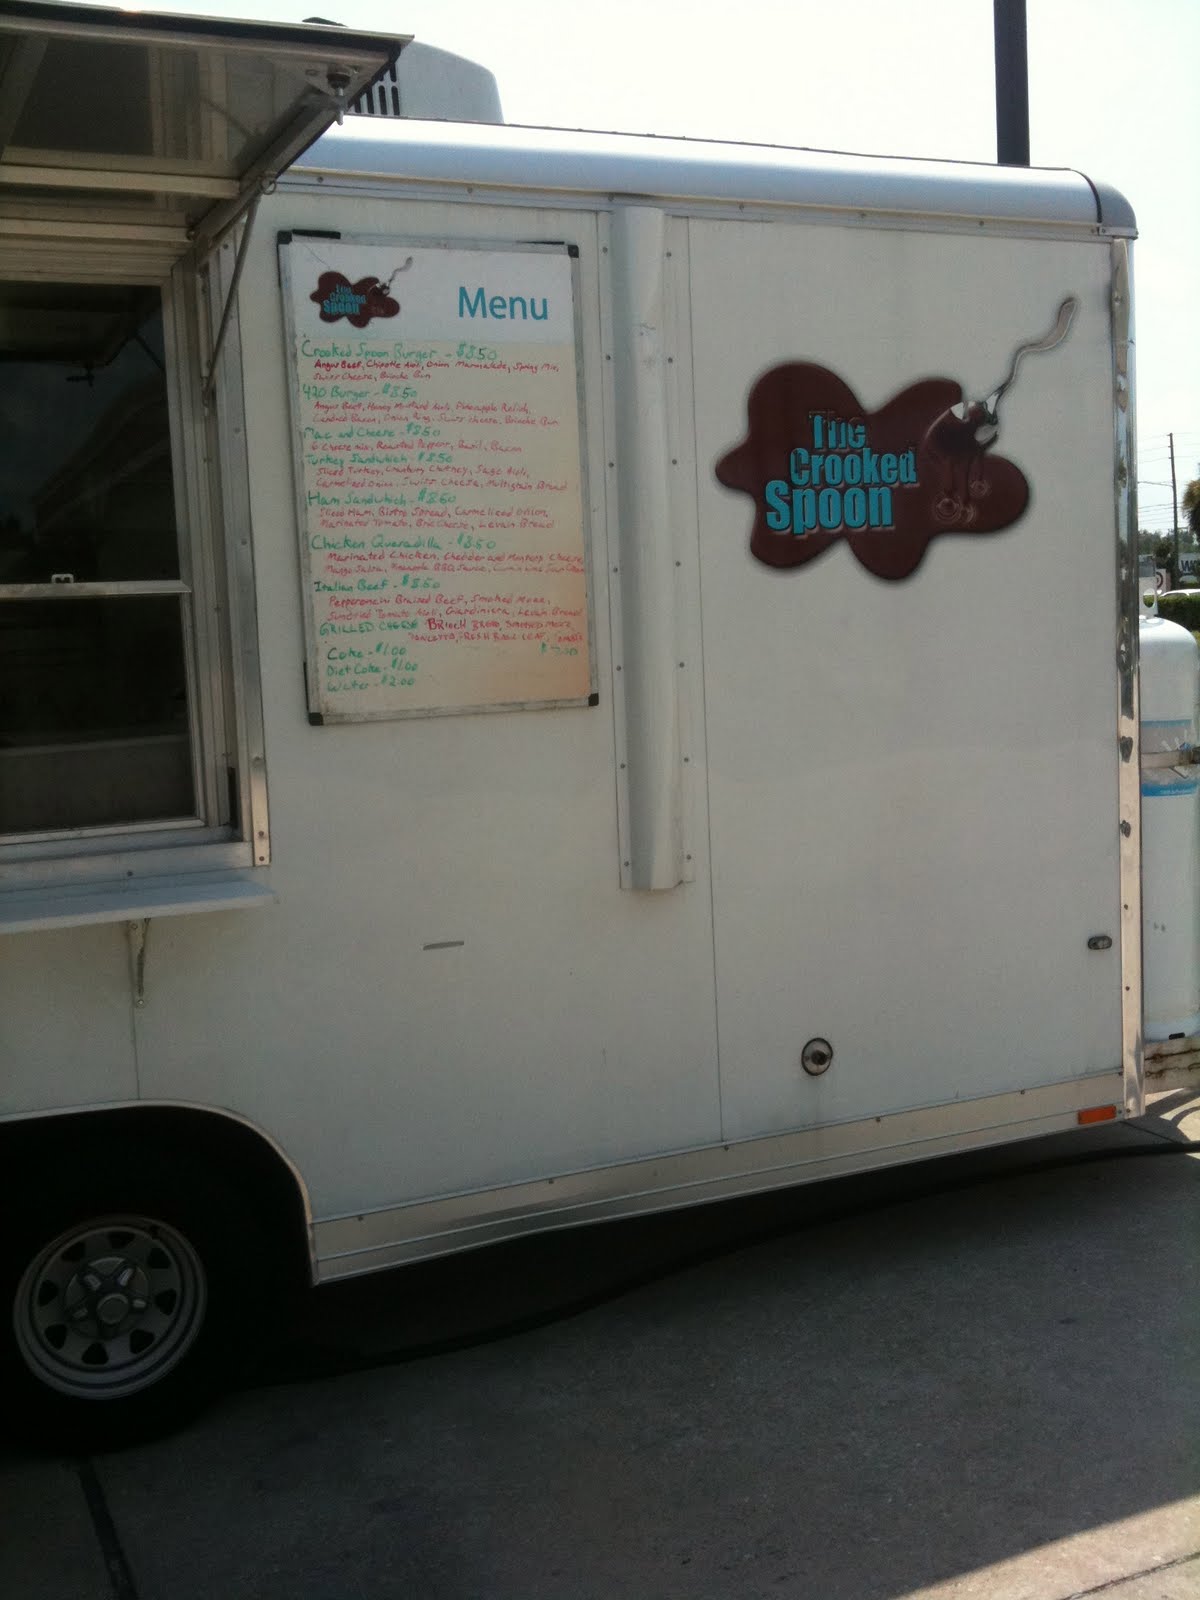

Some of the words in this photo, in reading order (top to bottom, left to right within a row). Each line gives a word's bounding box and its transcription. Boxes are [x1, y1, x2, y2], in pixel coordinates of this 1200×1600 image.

[458, 286, 549, 320] Menu
[302, 339, 352, 358] Crooked
[356, 342, 390, 360] Spoon
[394, 343, 438, 360] Burger
[302, 383, 327, 400] 420
[330, 385, 370, 402] Burger
[304, 426, 333, 440] Mac
[338, 425, 354, 439] and
[357, 426, 395, 438] Cheese
[812, 412, 867, 450] The
[305, 454, 344, 468] Turkey
[789, 446, 919, 487] Crooked
[308, 489, 340, 506] Ham
[765, 478, 895, 537] Spoon
[311, 534, 365, 550] Chicken
[328, 551, 386, 562] Marinated
[314, 580, 354, 592] Italian
[357, 578, 388, 591] Beef
[320, 621, 374, 636] GRILLED
[327, 647, 364, 661] Coke
[327, 665, 350, 677] Diet
[354, 663, 381, 675] Coke
[327, 680, 369, 692] Water
